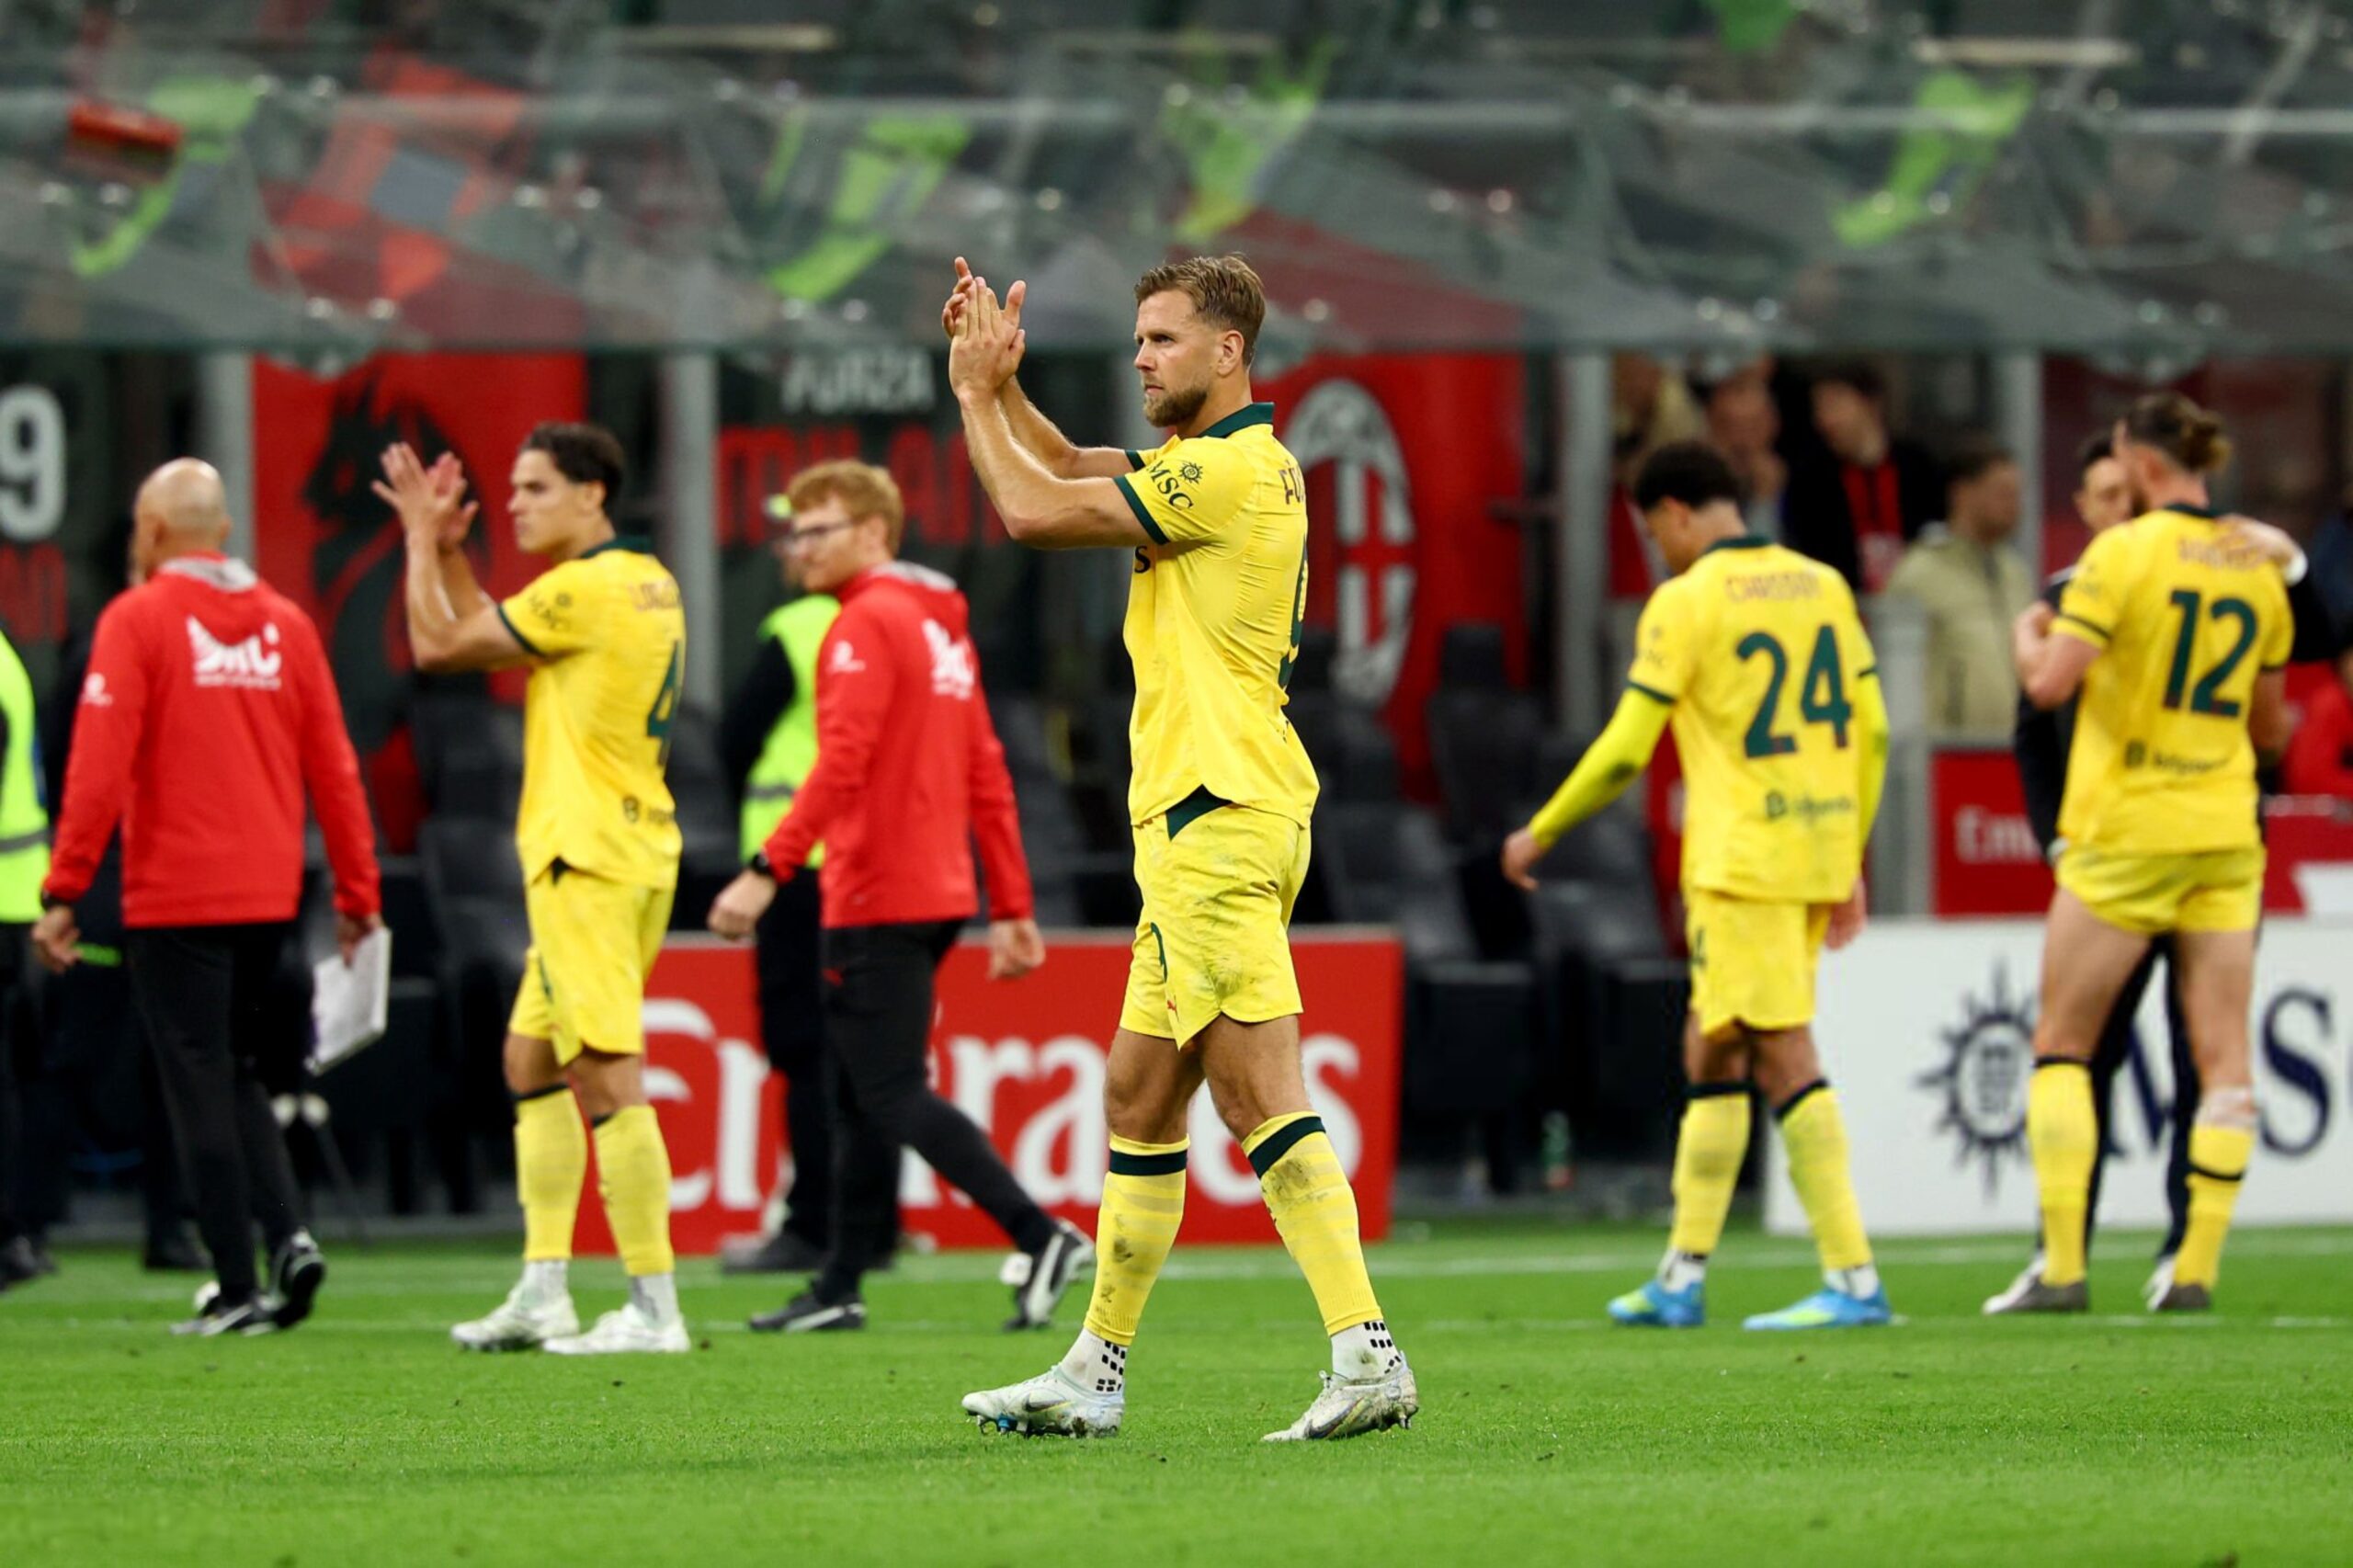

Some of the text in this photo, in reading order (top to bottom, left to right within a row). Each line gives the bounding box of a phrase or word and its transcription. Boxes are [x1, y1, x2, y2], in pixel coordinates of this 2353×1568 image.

[1146, 460, 1194, 511] MSC
[1735, 623, 1853, 758] 24
[2162, 588, 2258, 719] 12
